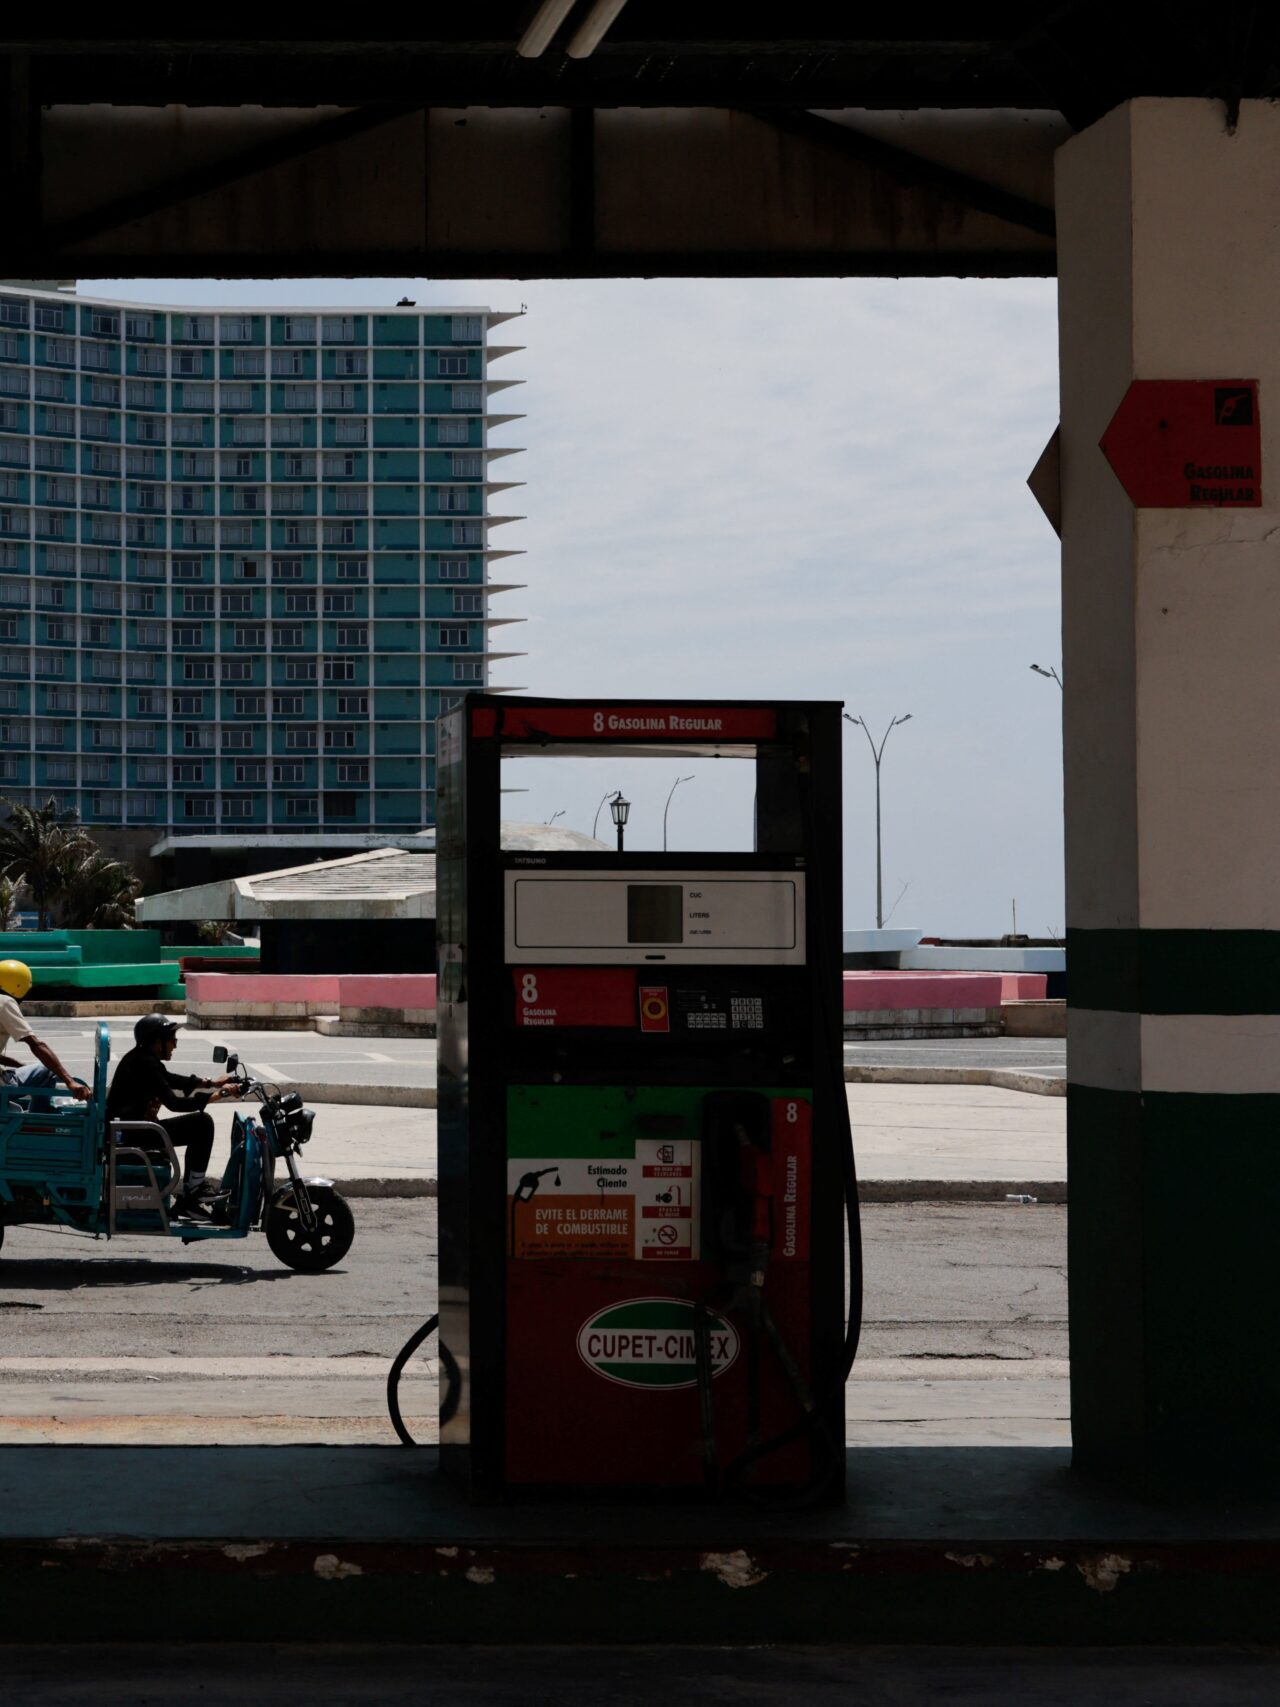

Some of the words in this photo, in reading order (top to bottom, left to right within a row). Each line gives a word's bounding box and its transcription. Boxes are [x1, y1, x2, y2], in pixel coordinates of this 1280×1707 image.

[1184, 462, 1254, 480] GASOLINA
[593, 712, 604, 732] 8
[608, 715, 667, 730] GASOLINA
[669, 715, 722, 730] REGULAR
[521, 973, 538, 1003] 8
[522, 1007, 558, 1016] GASOLINA
[522, 1016, 555, 1026] REGULAR
[786, 1102, 798, 1123] 8
[587, 1164, 628, 1175] Estimado
[596, 1178, 628, 1188] Cliente
[784, 1155, 798, 1203] REGULAR
[535, 1209, 563, 1220] EVITE
[566, 1209, 577, 1220] EL
[580, 1209, 628, 1220] DERRAME
[535, 1223, 549, 1235] DE
[556, 1223, 628, 1235] COMBUSTIBLE
[783, 1204, 797, 1257] GASOLINA
